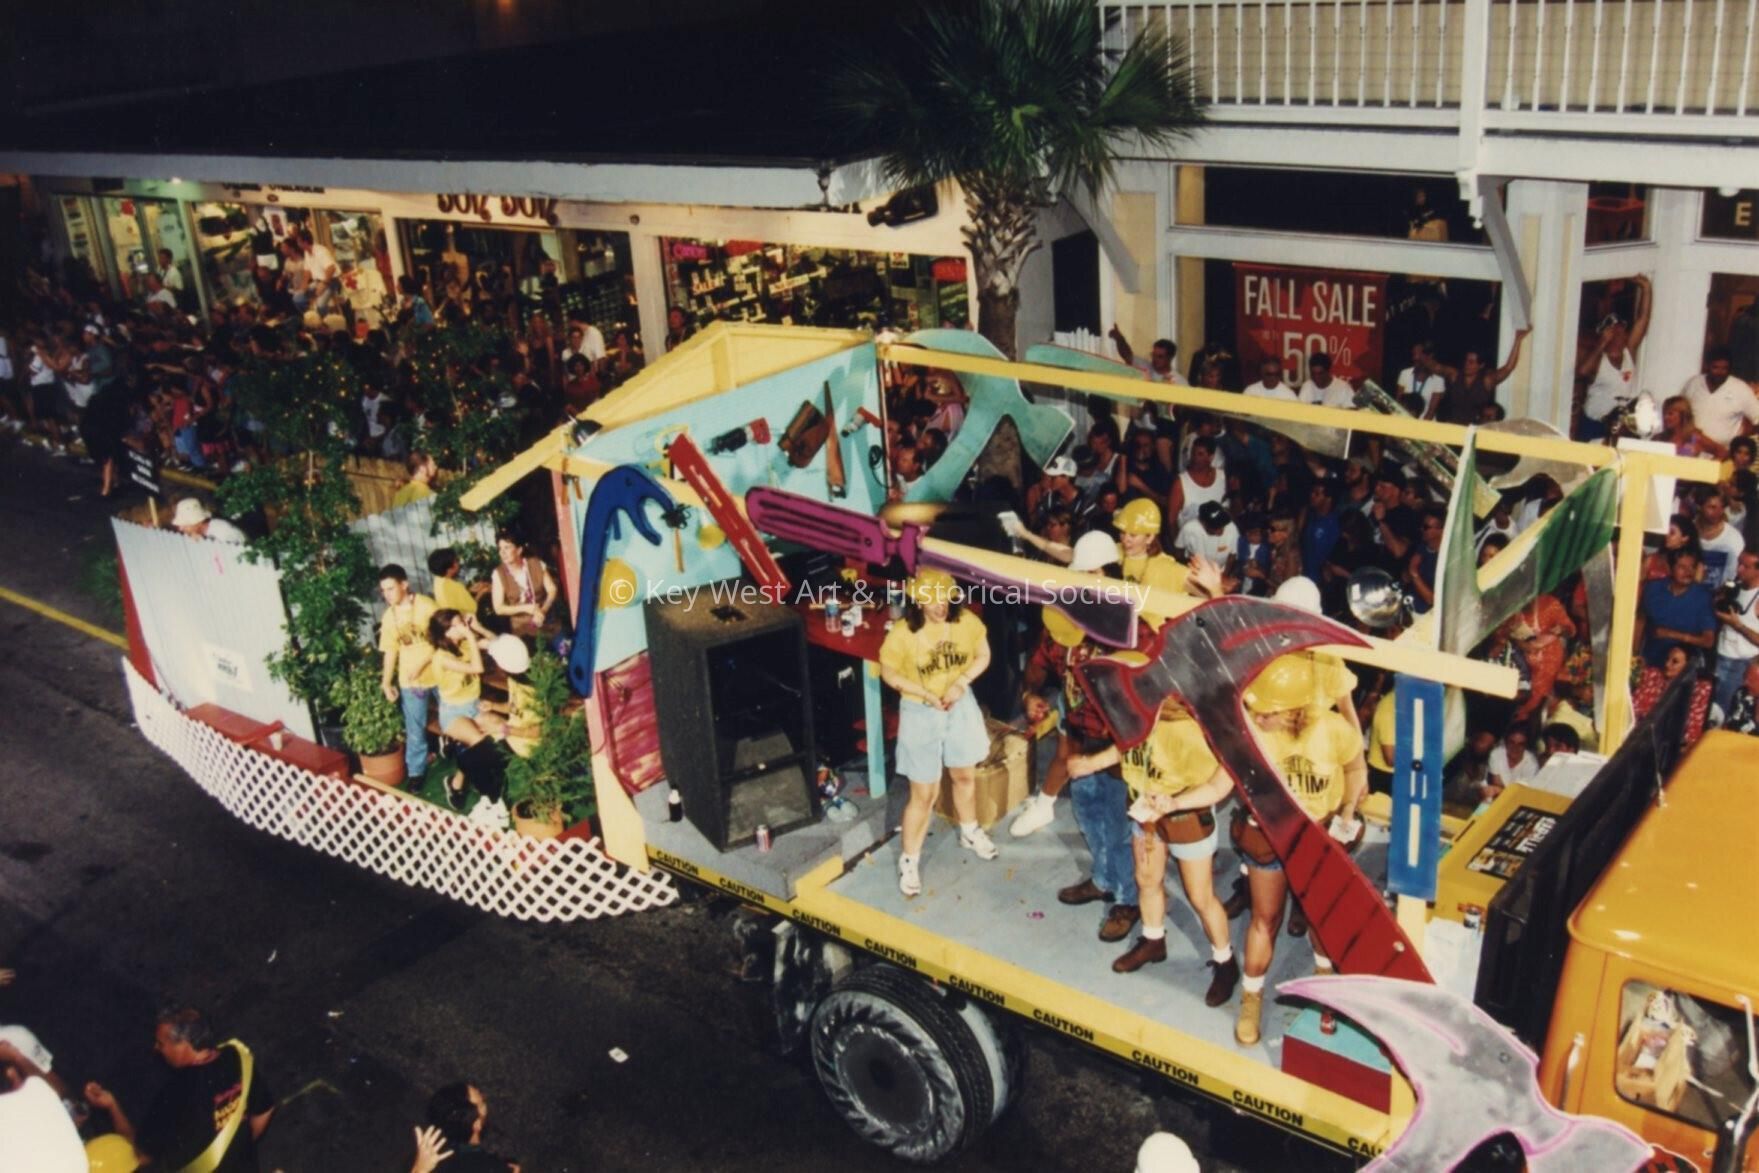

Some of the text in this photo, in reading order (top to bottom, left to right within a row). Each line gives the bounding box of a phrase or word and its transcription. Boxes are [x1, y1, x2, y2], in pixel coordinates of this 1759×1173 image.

[1735, 202, 1753, 227] E
[1244, 275, 1378, 328] FALL SALE
[656, 850, 699, 875] CAUTION
[719, 877, 765, 903] CAUTION
[792, 908, 841, 936] CAUTION
[864, 938, 917, 969] CAUTION
[949, 974, 1006, 1006] CAUTION
[1033, 1008, 1095, 1042] CAUTION
[1131, 1049, 1200, 1086] CAUTION
[1232, 1089, 1304, 1127] CAUTION
